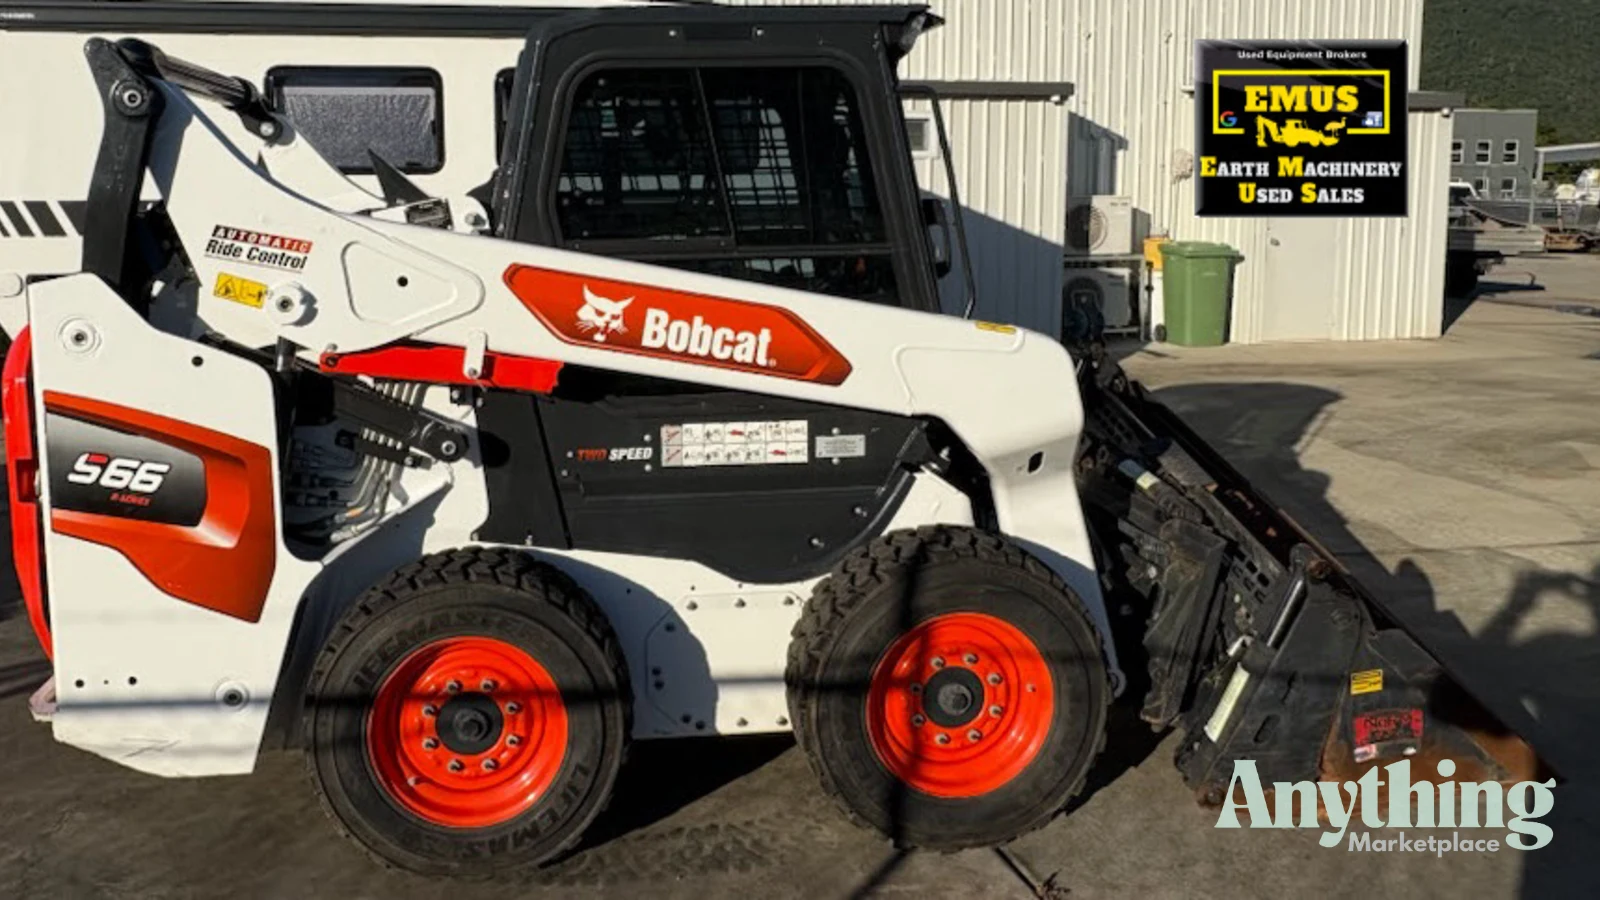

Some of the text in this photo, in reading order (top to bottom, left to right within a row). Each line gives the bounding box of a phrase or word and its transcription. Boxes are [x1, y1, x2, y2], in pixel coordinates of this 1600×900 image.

[205, 239, 308, 270] Ride Control
[214, 226, 310, 253] AUTOMATIC
[641, 307, 772, 366] Bobcat
[577, 447, 653, 461] TWO SPEED
[67, 452, 171, 494] S66
